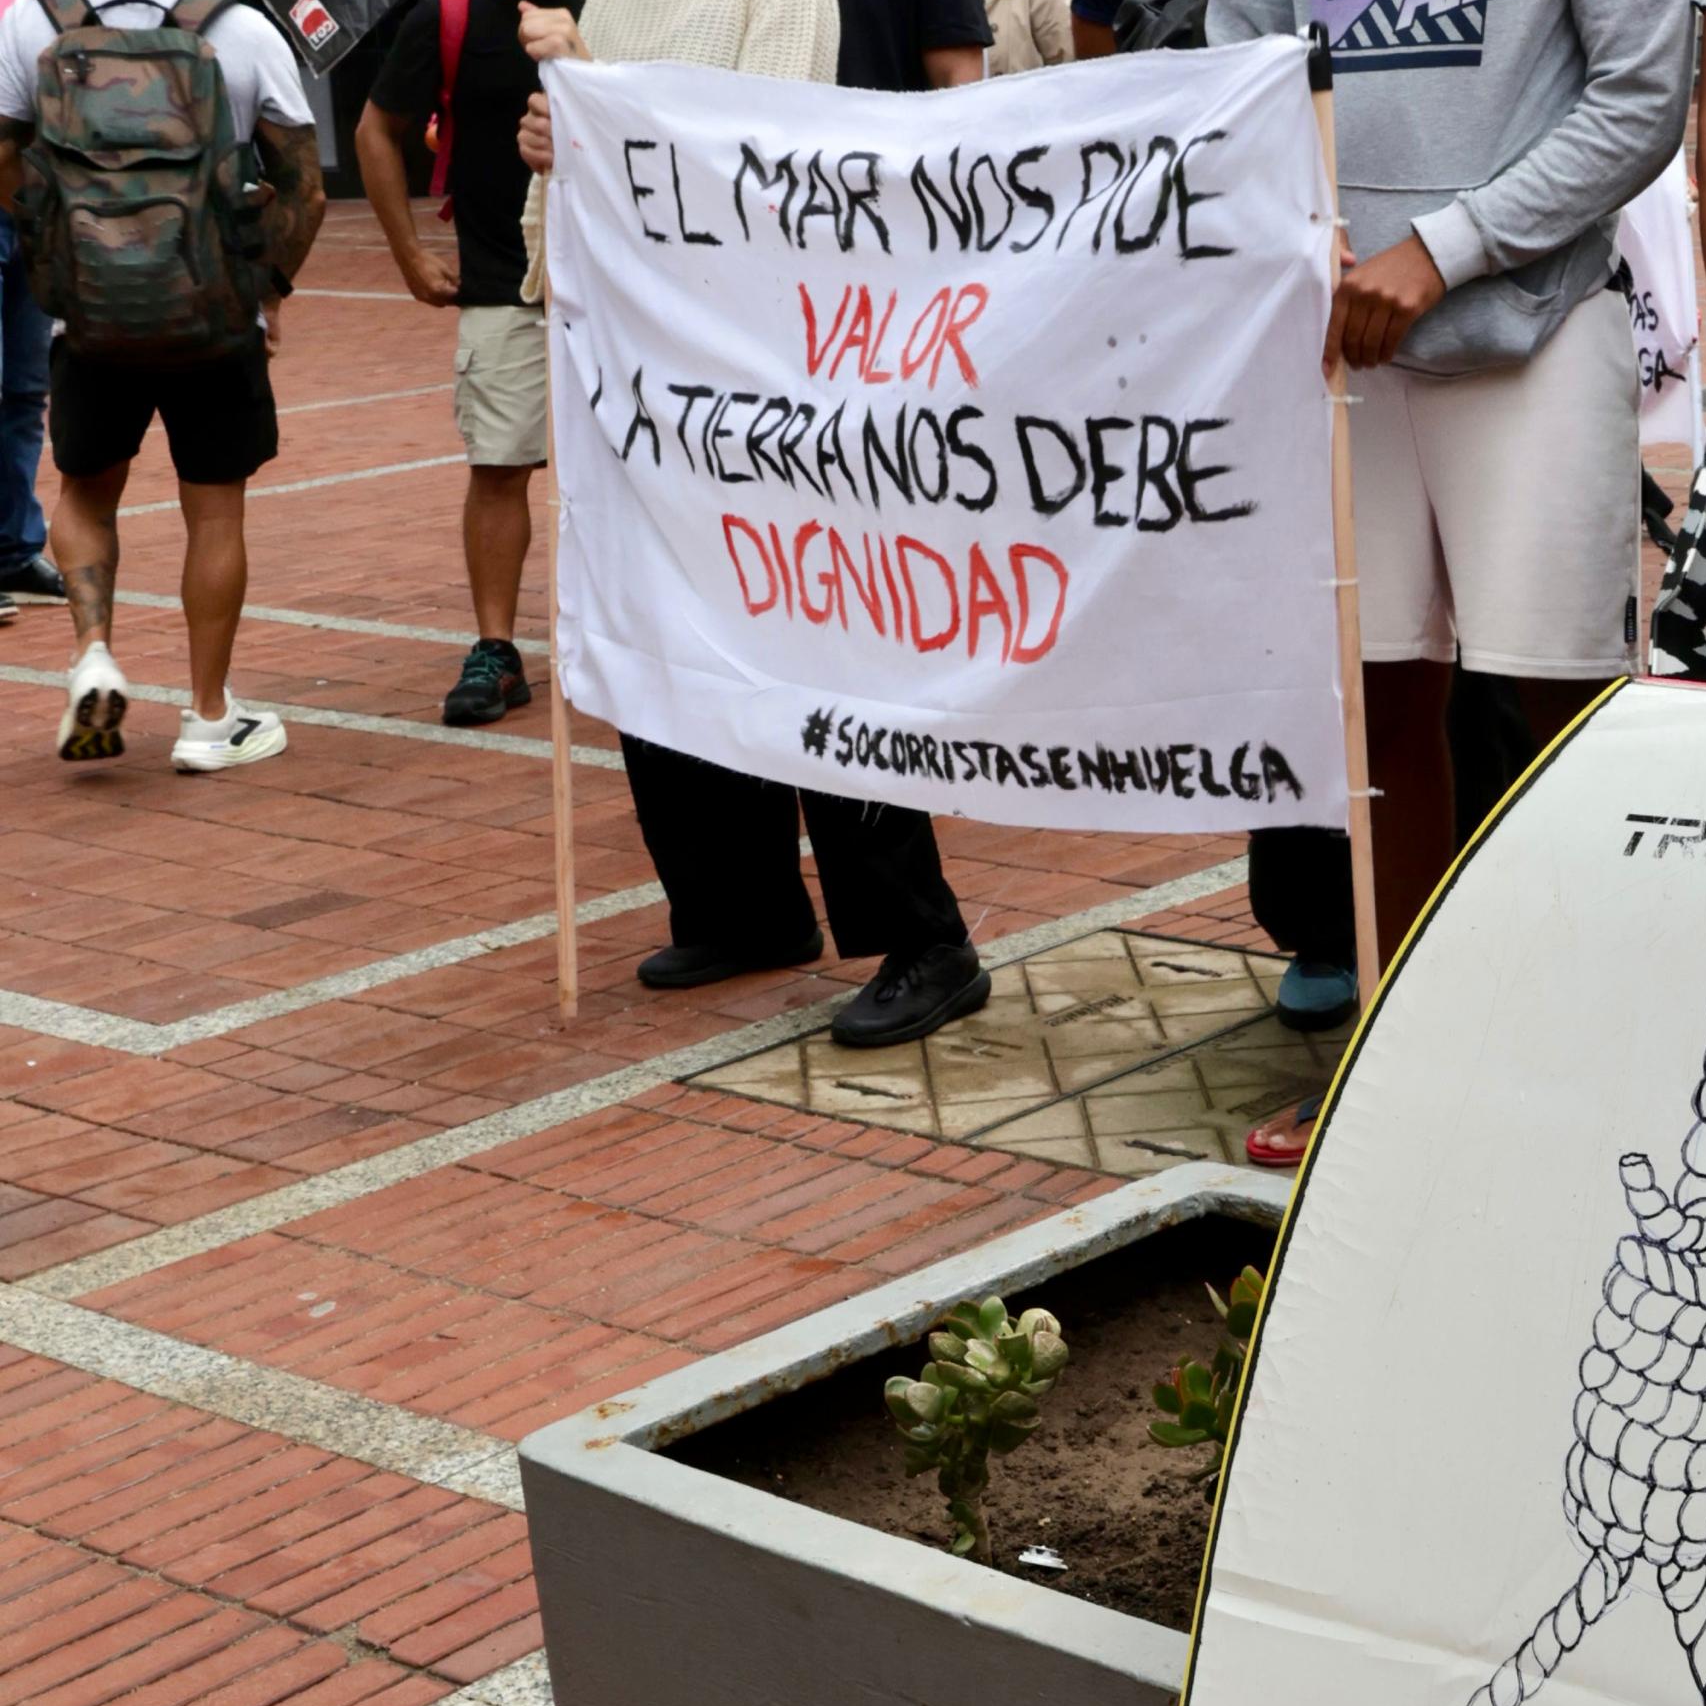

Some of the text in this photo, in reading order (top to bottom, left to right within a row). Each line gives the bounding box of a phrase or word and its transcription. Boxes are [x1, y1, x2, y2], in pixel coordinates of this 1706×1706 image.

[624, 139, 722, 246] EL
[733, 141, 893, 255] MAR
[911, 142, 1054, 254] NOS
[798, 281, 990, 391] VALOR
[668, 383, 863, 505] TIERRA
[862, 401, 998, 514] NOS
[1015, 413, 1259, 533] DEBE
[722, 513, 1069, 666] DIGNIDAD
